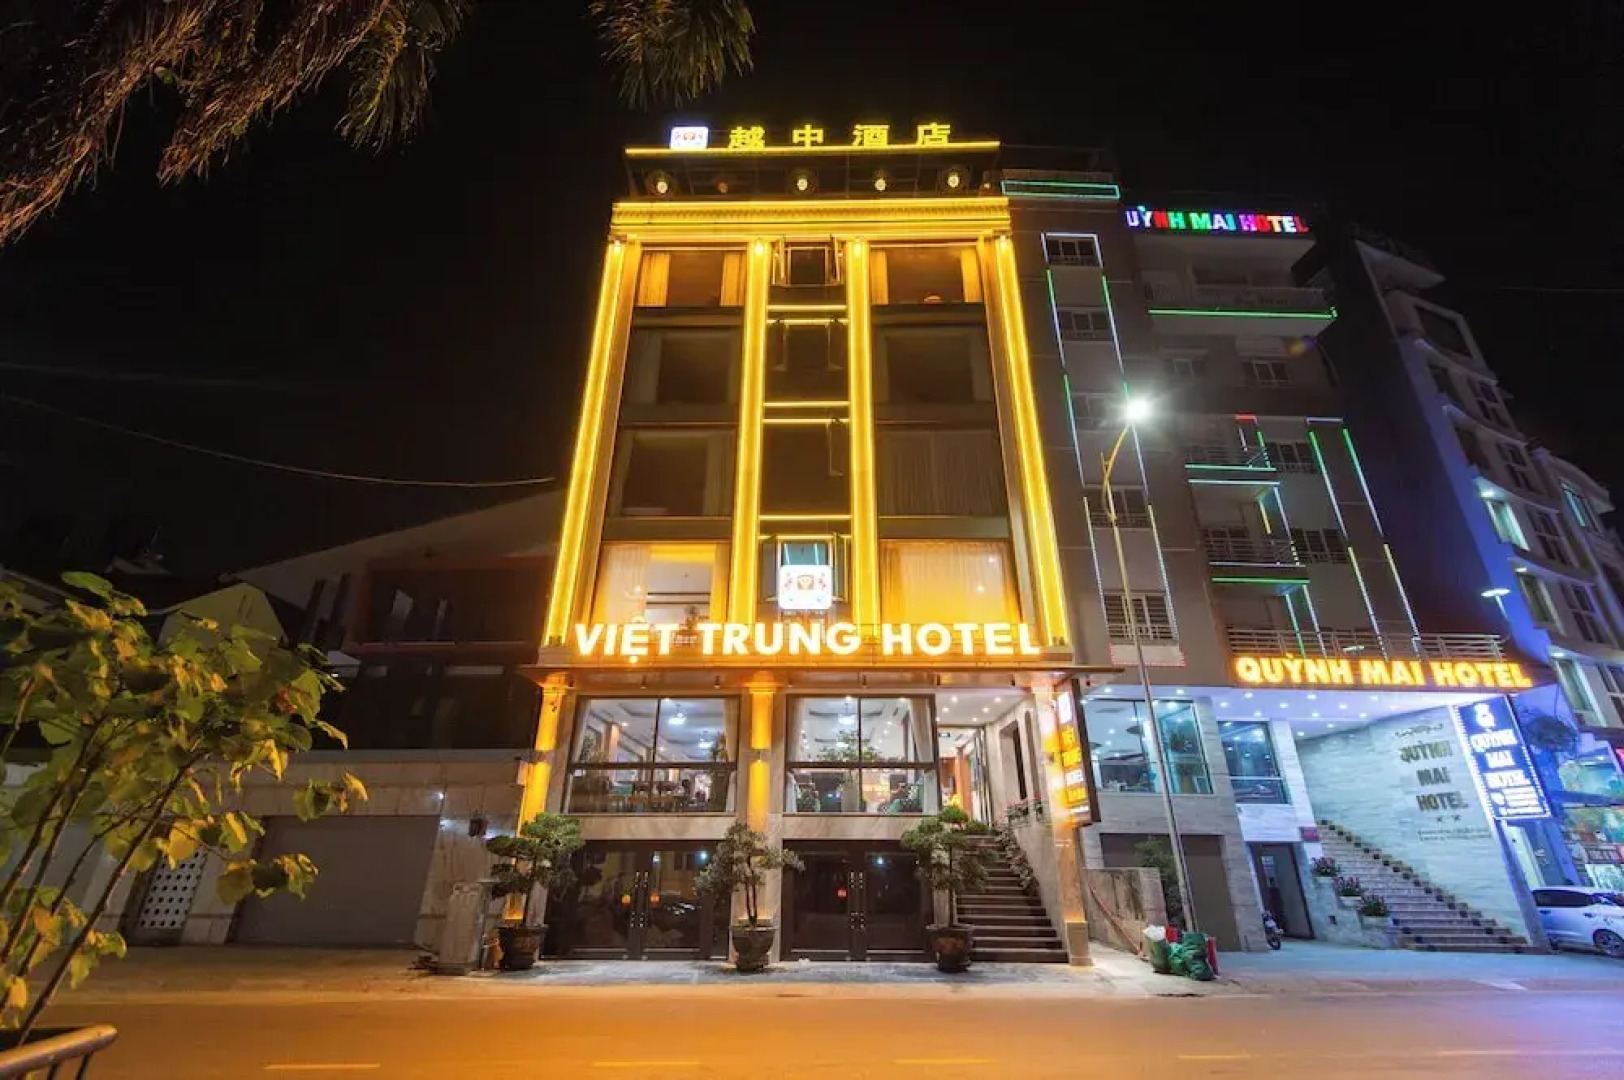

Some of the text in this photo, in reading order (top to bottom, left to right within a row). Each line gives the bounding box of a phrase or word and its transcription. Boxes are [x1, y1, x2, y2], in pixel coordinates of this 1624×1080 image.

[728, 122, 951, 149] 越中酒店
[1190, 212, 1236, 231] MAI
[1239, 213, 1309, 232] HOTEL
[575, 616, 679, 663] VIỆT
[697, 622, 861, 656] TRUNG
[883, 622, 1041, 656] HOTEL
[1236, 653, 1533, 688] QUỲNH MAI HOTEL
[1416, 766, 1450, 786] MAI
[1416, 791, 1468, 812] HOTEL
